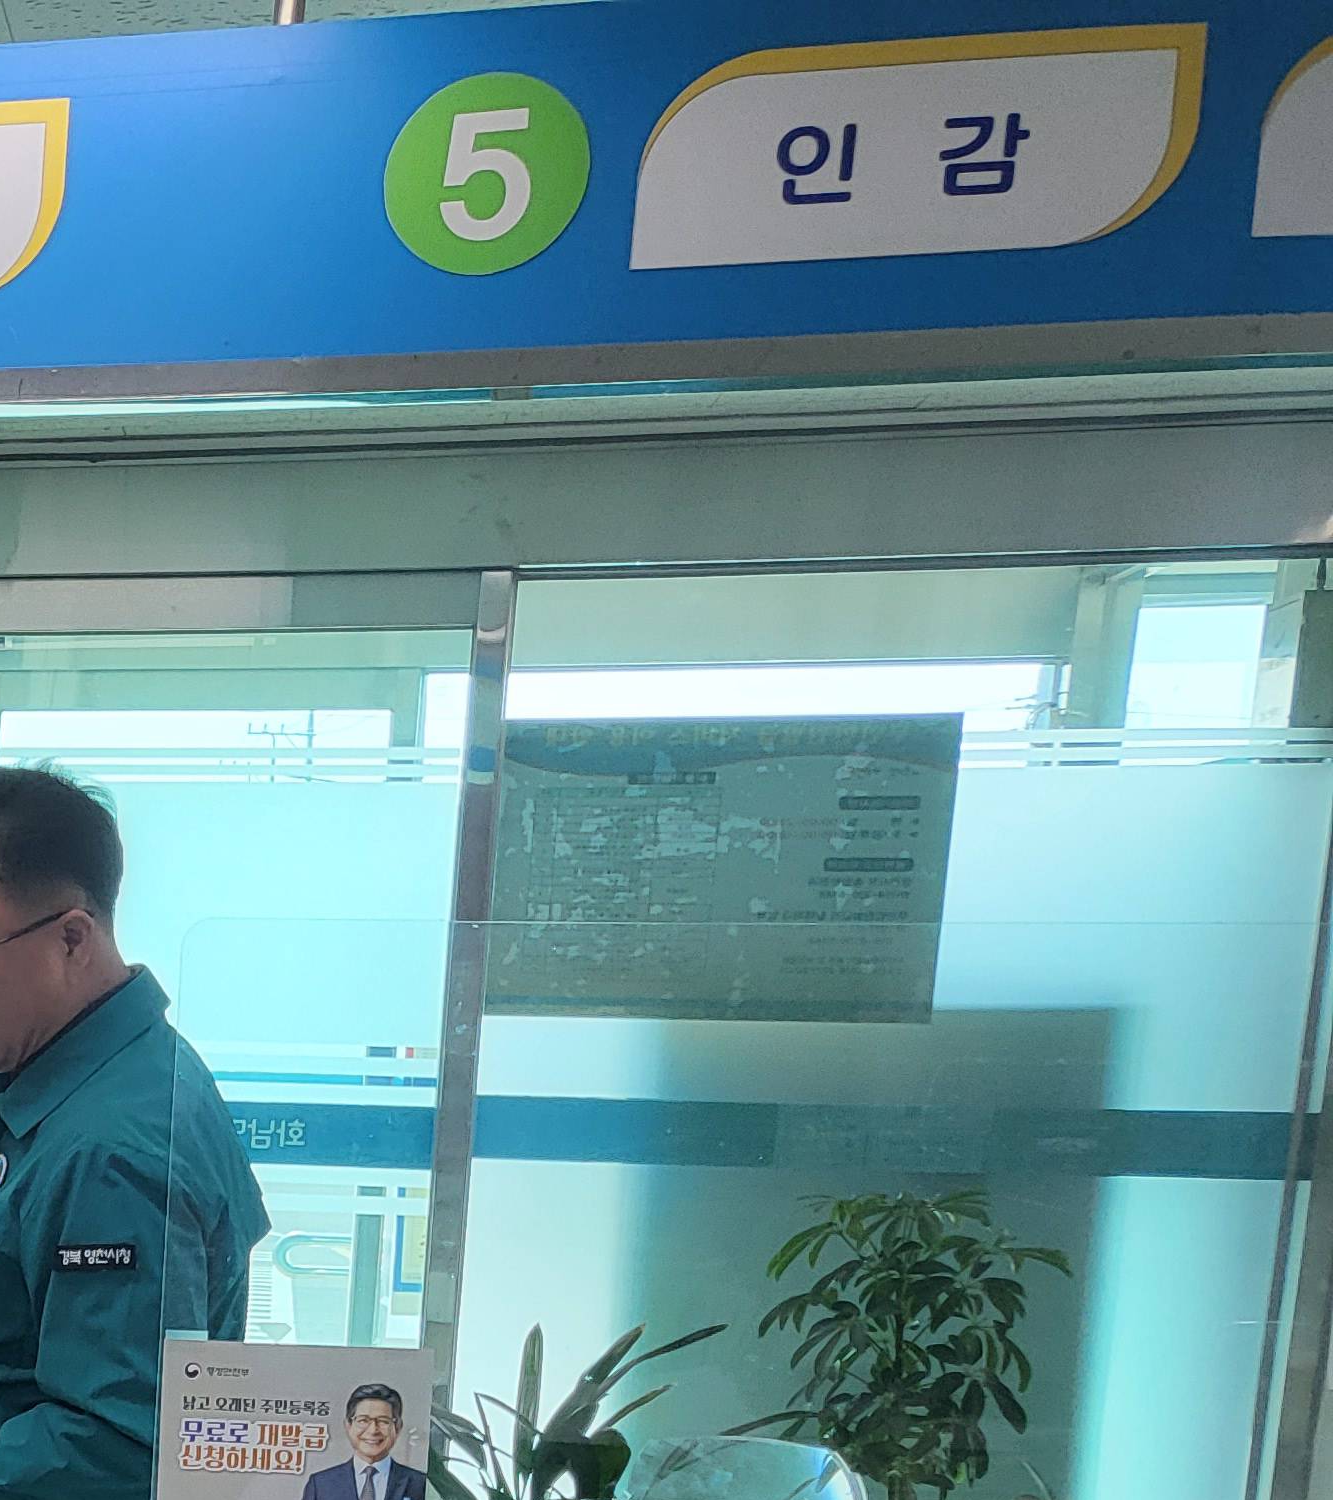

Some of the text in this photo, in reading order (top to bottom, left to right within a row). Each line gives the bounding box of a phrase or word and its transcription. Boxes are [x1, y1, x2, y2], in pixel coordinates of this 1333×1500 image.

[439, 107, 531, 241] 5
[58, 1248, 131, 1265] 경북 영천시청
[182, 1395, 330, 1416] 낡고 오래된 주민등록증
[182, 1420, 327, 1448] 무료로 재발급
[180, 1445, 302, 1472] 신청하세요!
